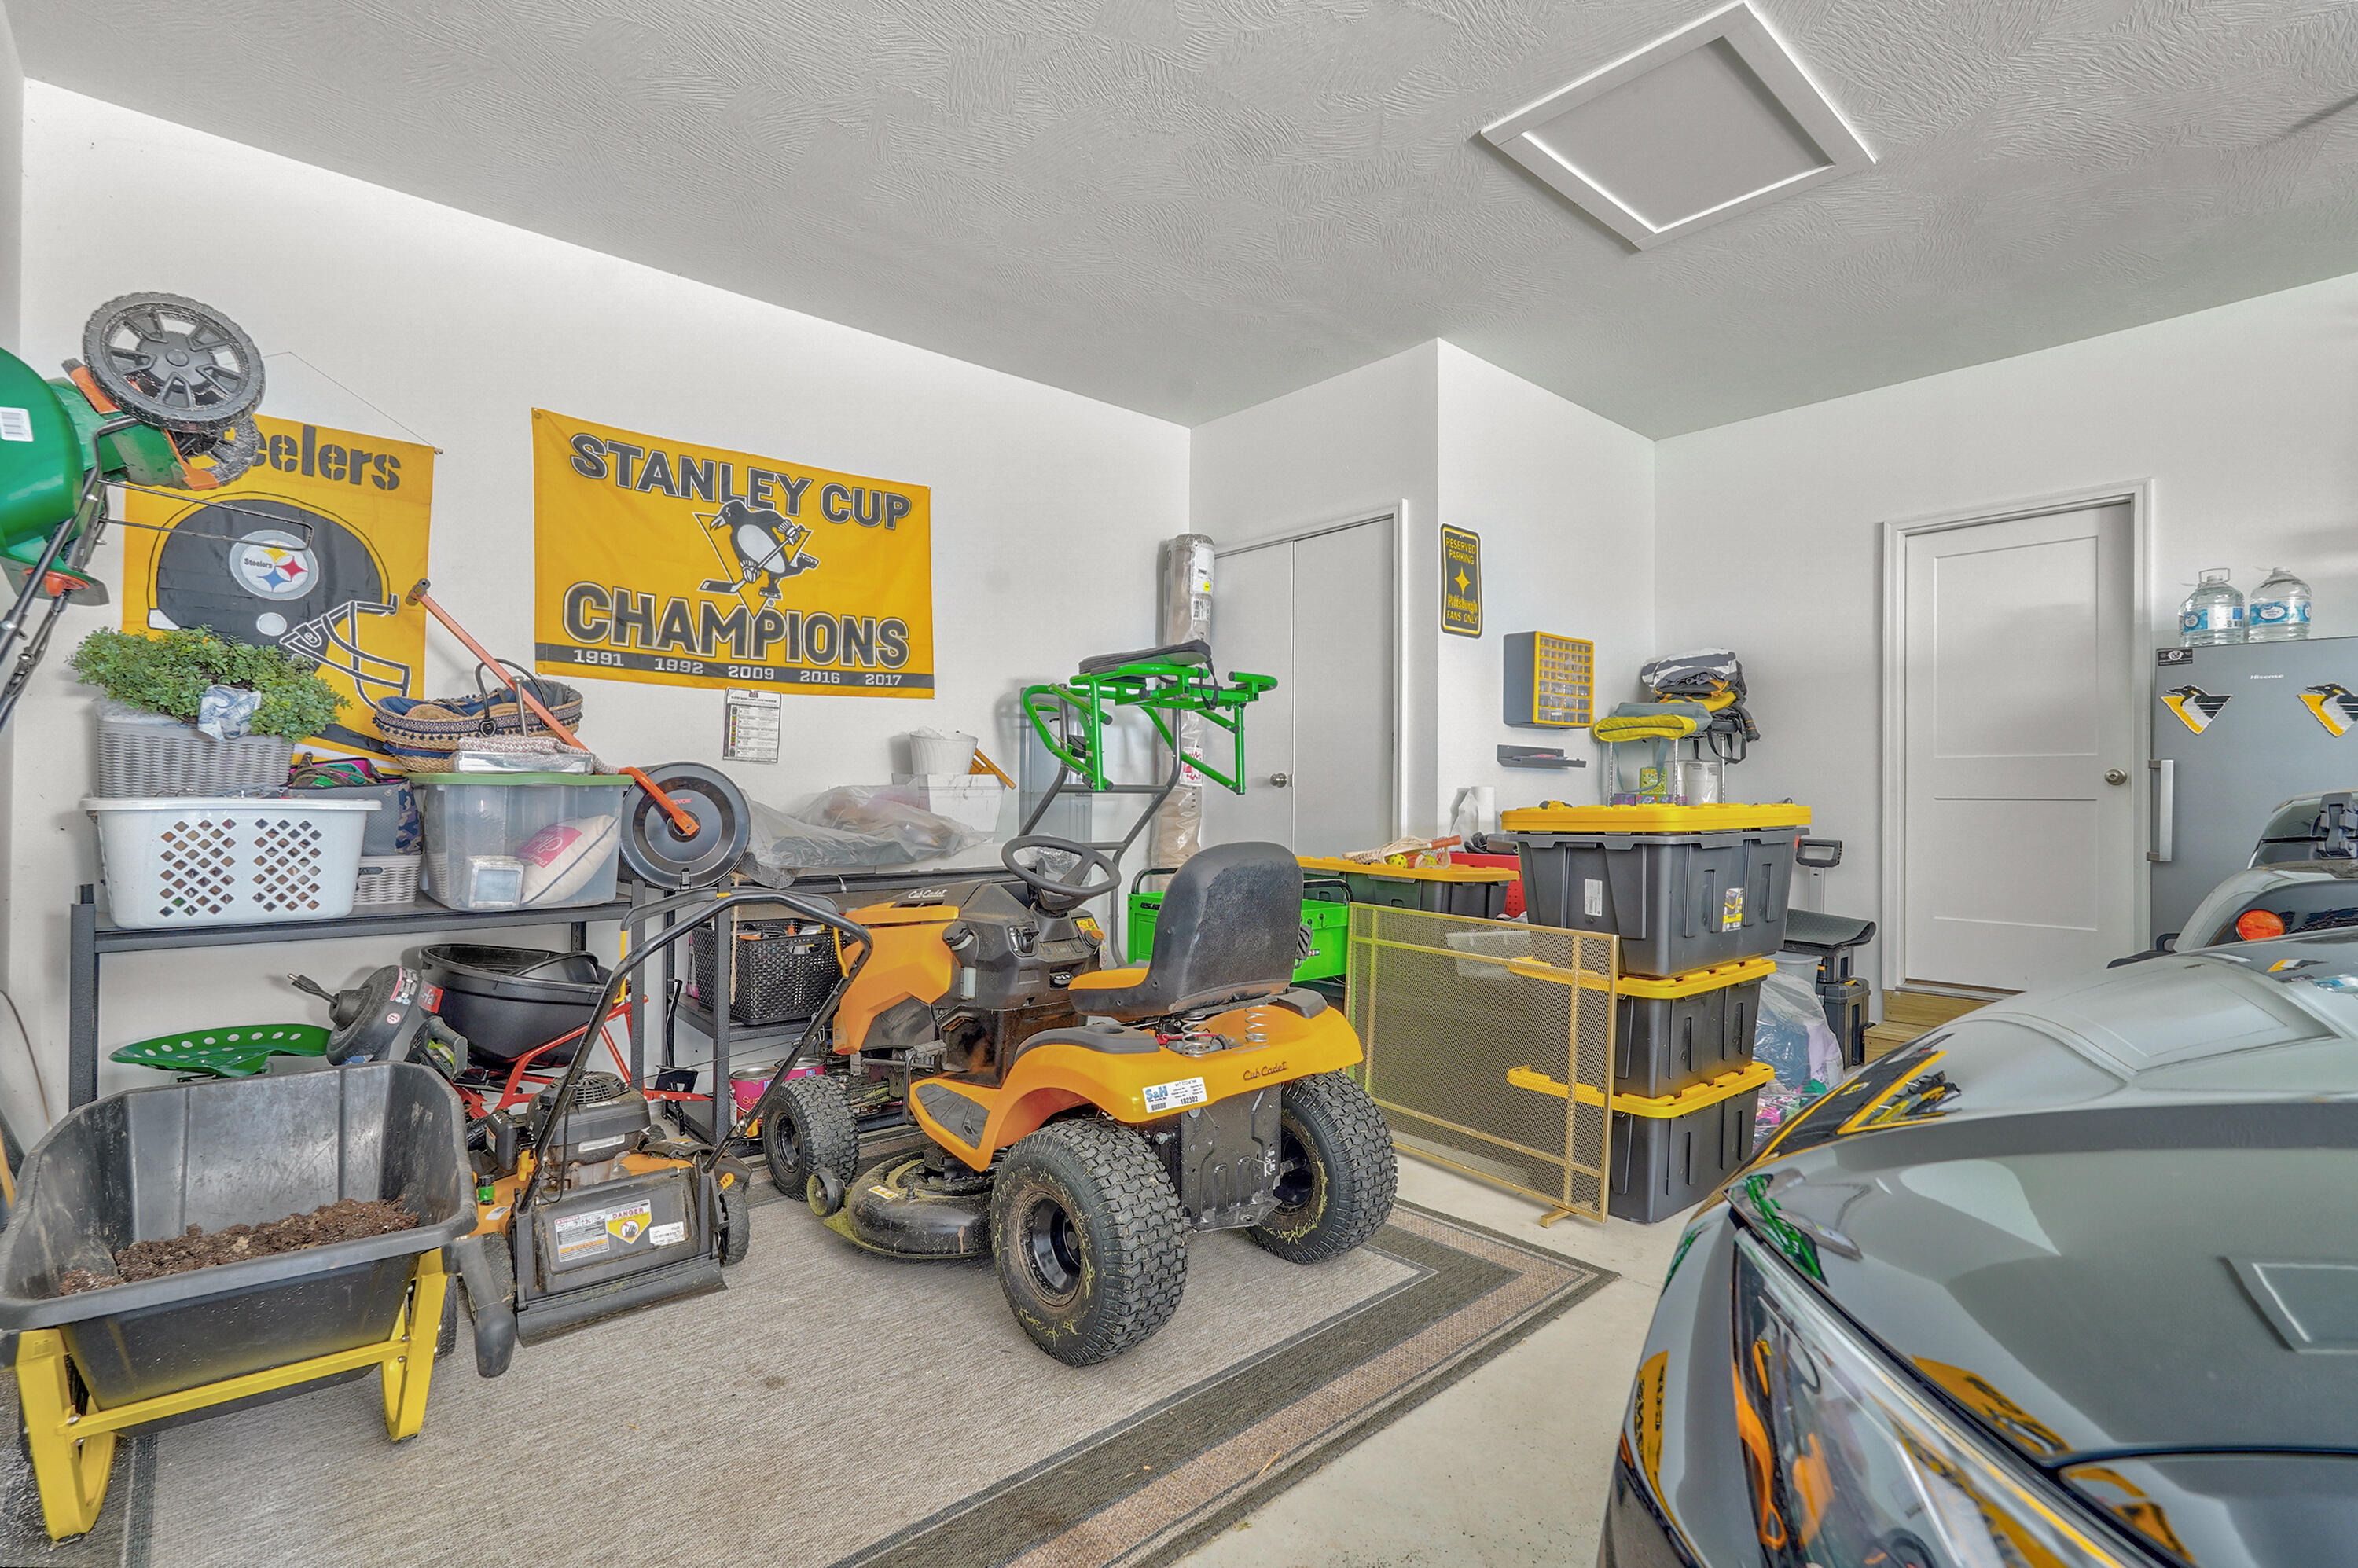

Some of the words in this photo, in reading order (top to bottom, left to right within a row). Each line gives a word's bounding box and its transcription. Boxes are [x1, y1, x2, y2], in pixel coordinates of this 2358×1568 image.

[570, 433, 814, 516] STANLEY
[821, 483, 912, 530] CUP
[1445, 537, 1477, 554] RESERVED
[244, 557, 273, 569] Steelers
[1449, 549, 1475, 565] PARKING
[1447, 593, 1478, 614] Pittsburgh
[563, 581, 910, 669] CHAMPIONS
[1446, 610, 1462, 622] FANS
[1464, 613, 1478, 624] ONLY
[573, 648, 625, 667] 1991
[654, 657, 704, 675] 1992
[728, 665, 775, 681] 2009
[799, 670, 841, 685] 2016
[865, 674, 902, 686] 2017
[908, 890, 923, 898] Cub
[923, 889, 948, 898] Cadet
[1243, 1067, 1259, 1081] Cub
[1260, 1061, 1287, 1077] Cadet
[1145, 1085, 1169, 1100] S&H
[612, 1207, 645, 1219] DANGER
